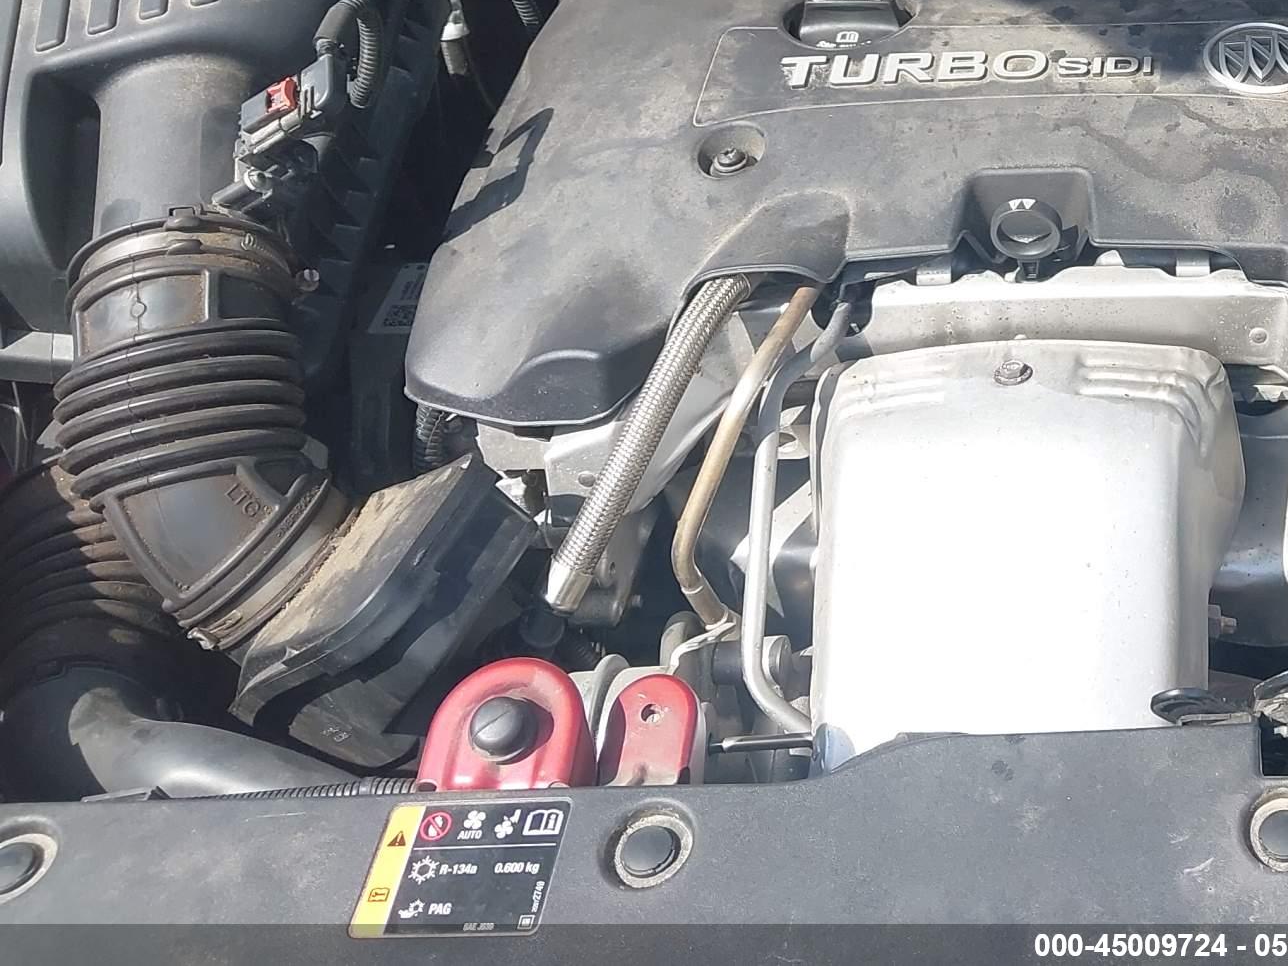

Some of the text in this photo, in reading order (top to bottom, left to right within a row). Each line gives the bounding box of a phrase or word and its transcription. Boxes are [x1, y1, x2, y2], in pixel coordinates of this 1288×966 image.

[781, 50, 1154, 90] TURBO SIDI
[456, 830, 482, 840] AUTO
[438, 861, 540, 875] R-134a 0.600 kg
[428, 903, 452, 915] PAG
